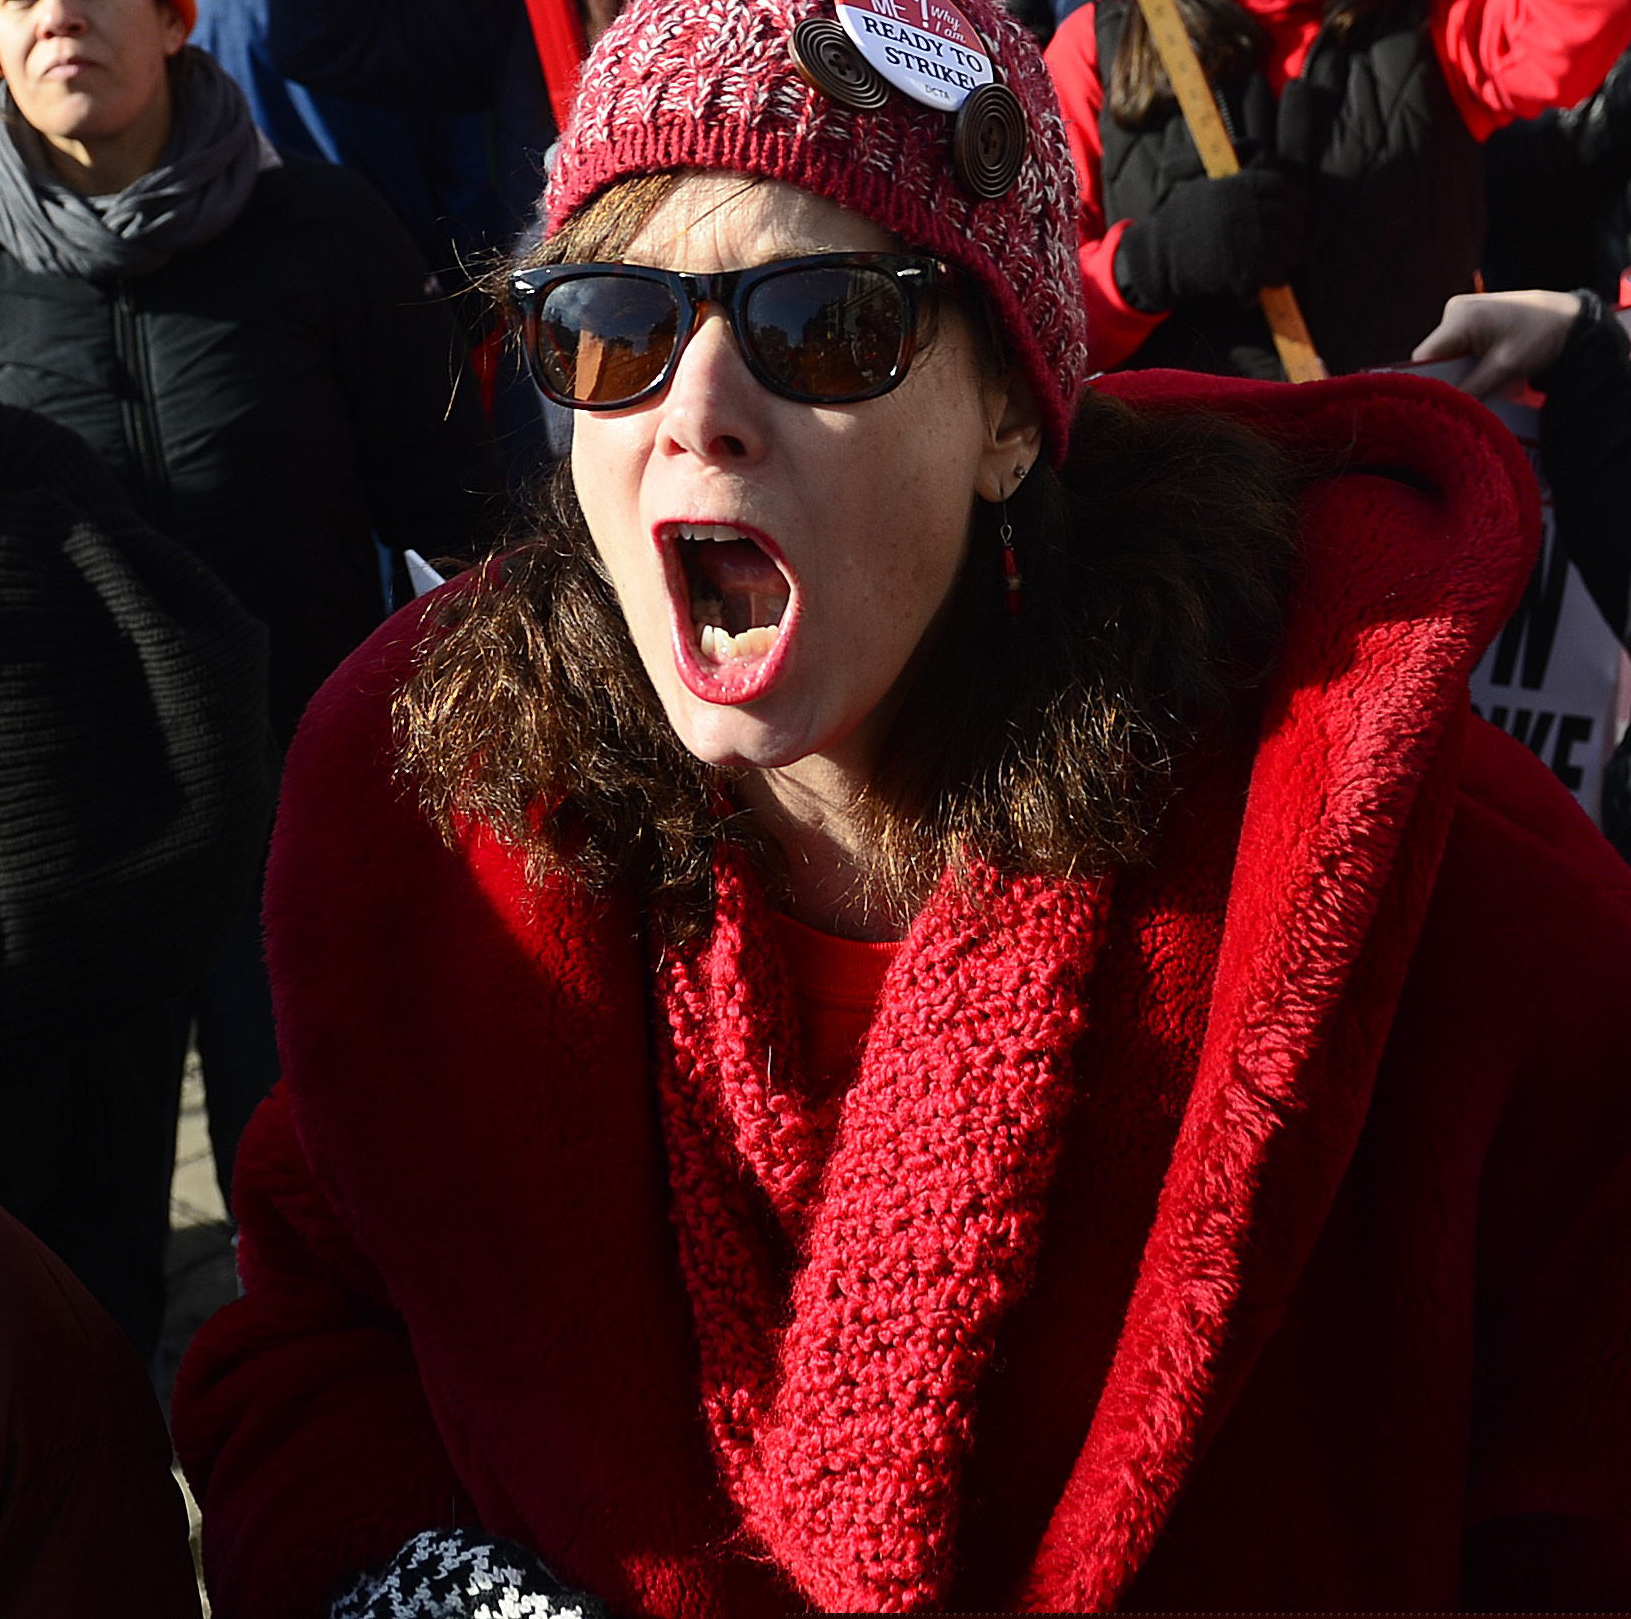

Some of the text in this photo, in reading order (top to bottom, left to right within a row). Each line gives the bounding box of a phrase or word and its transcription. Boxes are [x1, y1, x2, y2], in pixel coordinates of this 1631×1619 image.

[930, 4, 961, 32] Why
[861, 15, 984, 73] READY TO
[944, 29, 967, 44] am
[884, 45, 977, 91] STRIKE!
[925, 84, 951, 101] DCTA
